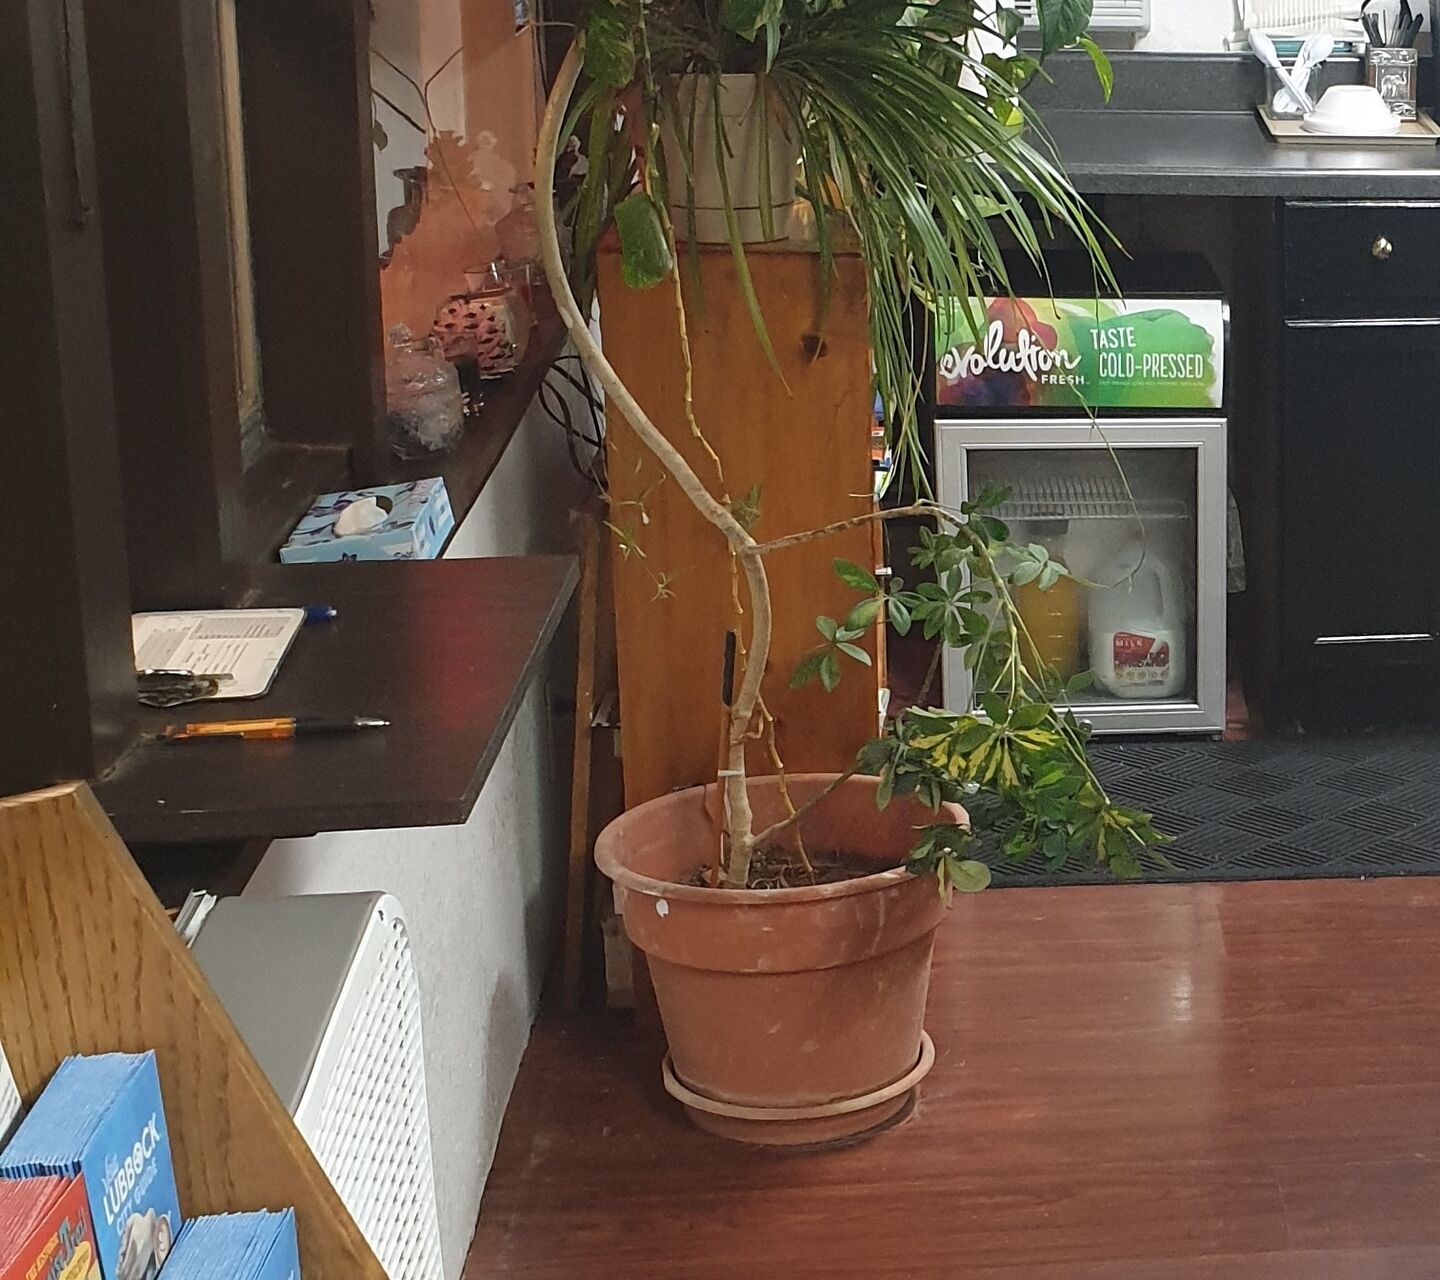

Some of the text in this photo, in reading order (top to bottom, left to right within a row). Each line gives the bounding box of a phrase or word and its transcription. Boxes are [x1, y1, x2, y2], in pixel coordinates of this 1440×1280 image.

[939, 319, 1082, 382] evolution
[1090, 326, 1136, 350] TASTE
[1099, 352, 1204, 379] COLD-PRESSED
[1041, 374, 1085, 385] FRESH
[103, 1112, 161, 1226] LUBBOCK
